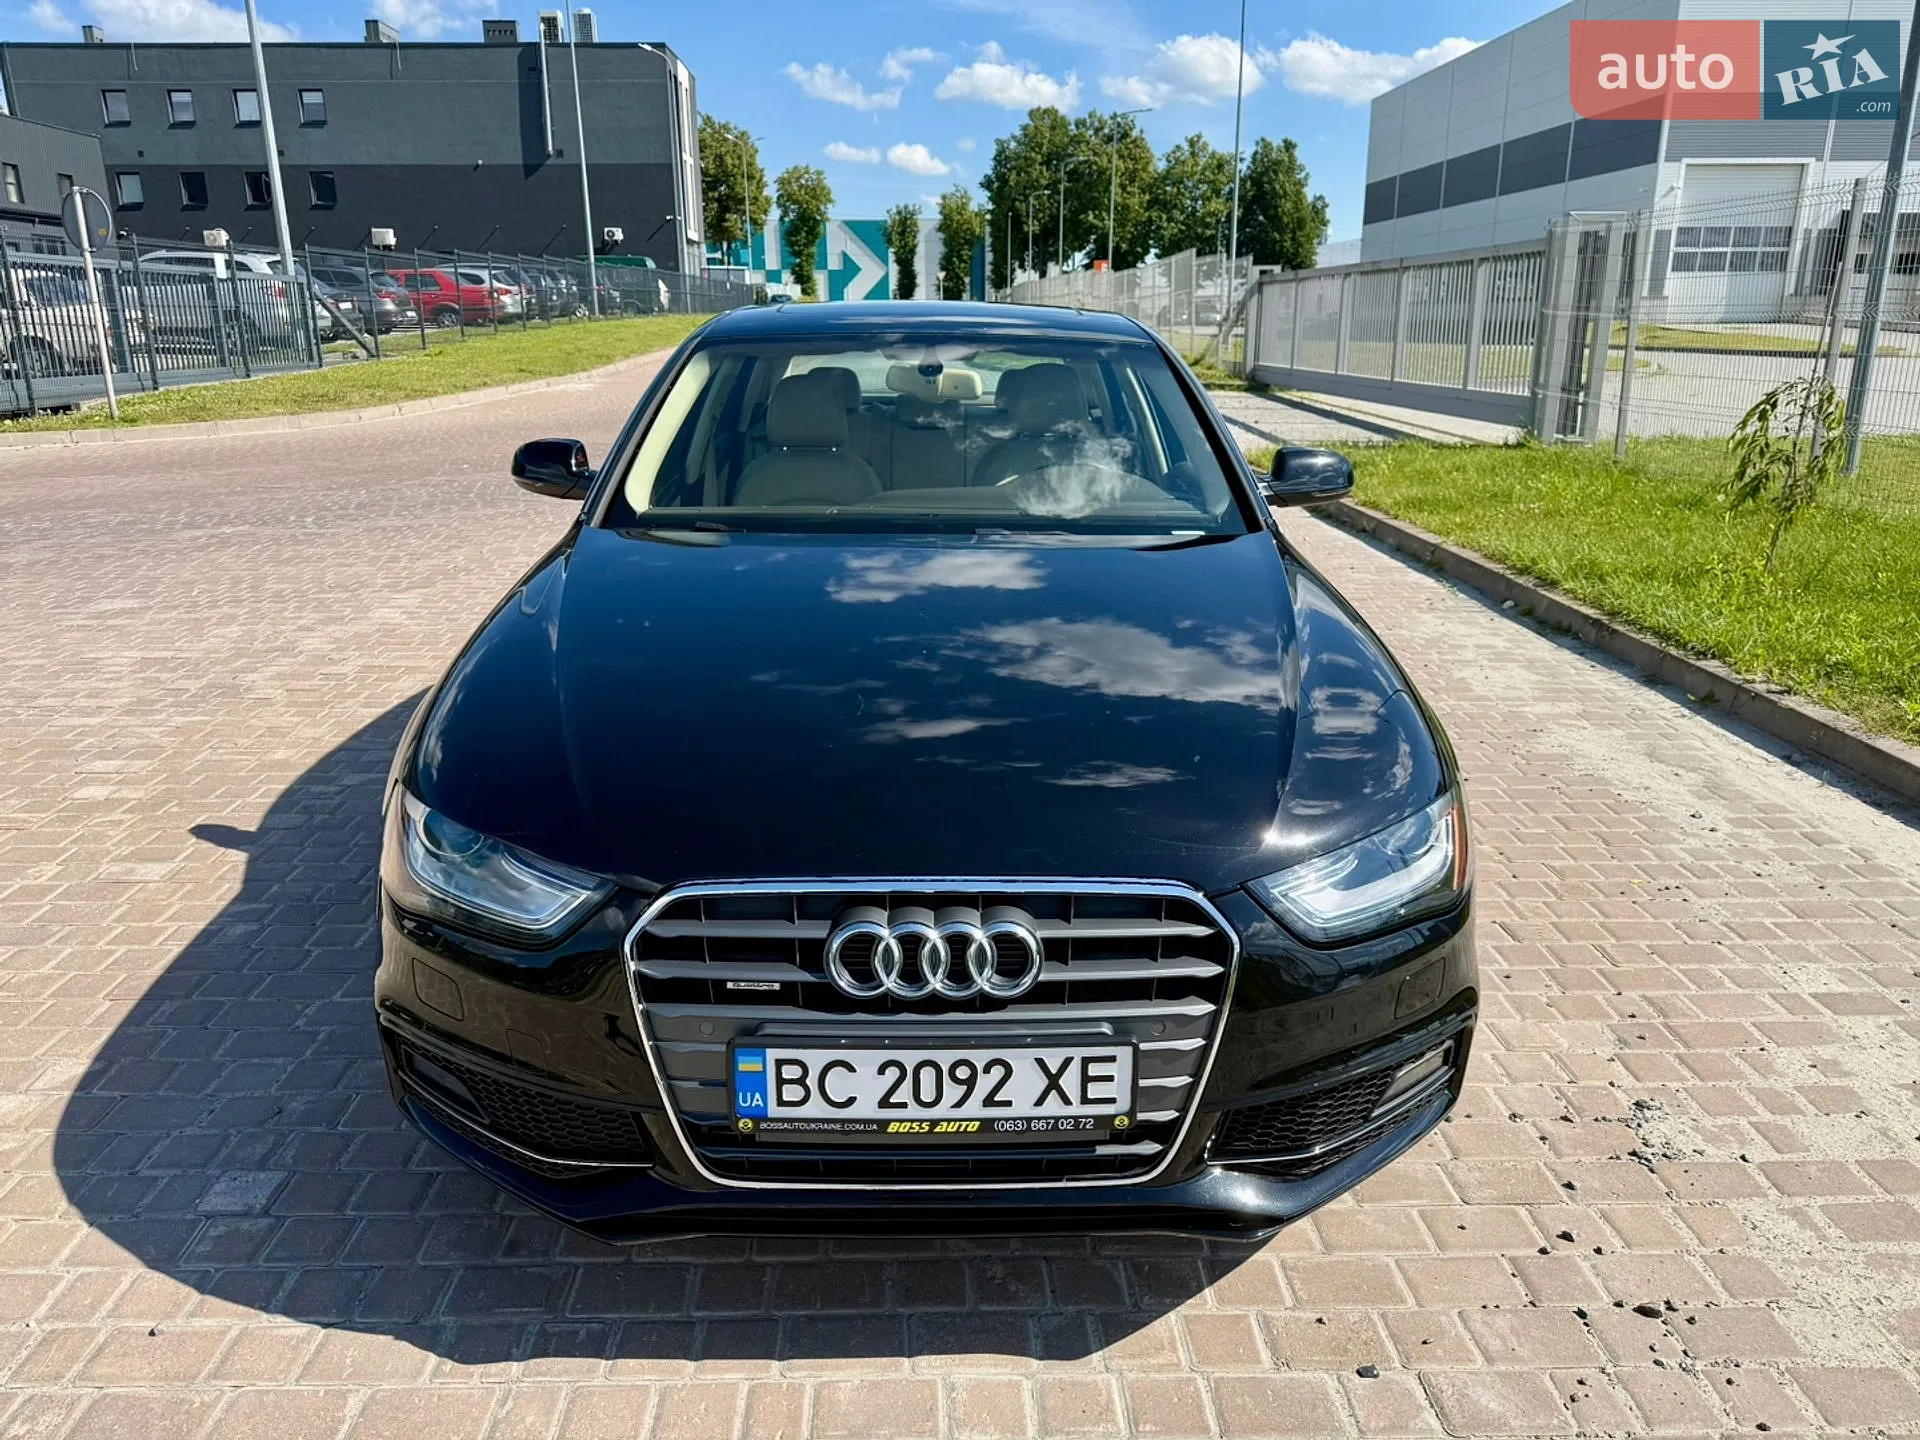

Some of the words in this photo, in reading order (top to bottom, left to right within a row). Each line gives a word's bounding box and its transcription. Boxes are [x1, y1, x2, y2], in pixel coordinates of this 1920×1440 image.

[774, 1057, 858, 1110] BC
[877, 1058, 1014, 1110] 2092
[1032, 1055, 1118, 1108] XE
[738, 1092, 764, 1108] UA
[887, 1121, 931, 1133] BOSS
[933, 1121, 981, 1133] AUTO
[994, 1119, 1027, 1132] (063)
[1030, 1119, 1054, 1131] 667
[1058, 1119, 1075, 1130] 02
[1078, 1118, 1094, 1130] 72
